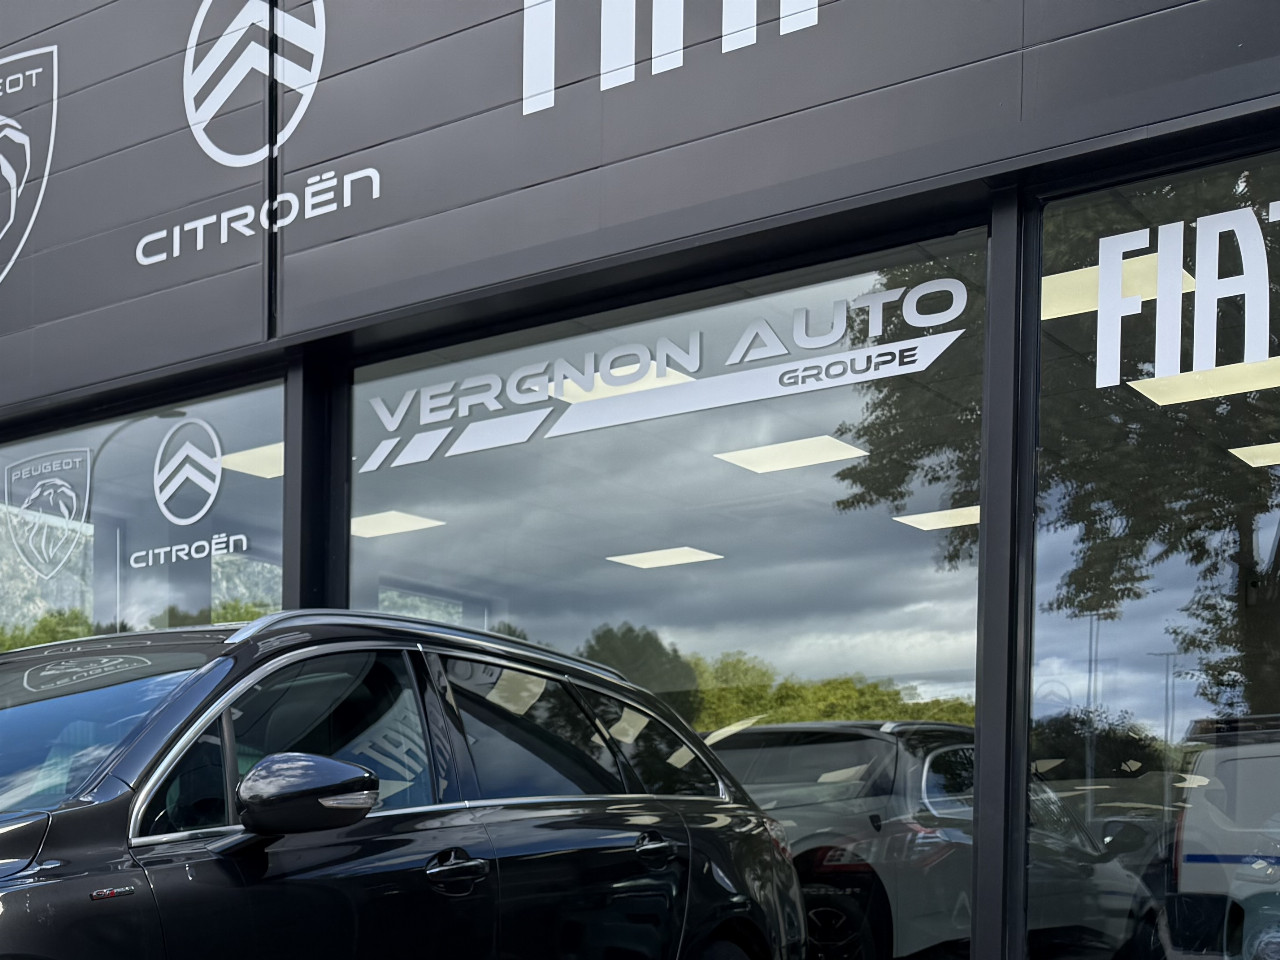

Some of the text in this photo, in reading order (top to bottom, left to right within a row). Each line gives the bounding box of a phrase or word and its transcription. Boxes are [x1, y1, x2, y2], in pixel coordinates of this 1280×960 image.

[1097, 200, 1280, 388] FIA
[370, 278, 968, 433] VERGNON AUTO
[777, 345, 919, 388] GROUPE
[12, 457, 82, 482] PEUGEOT
